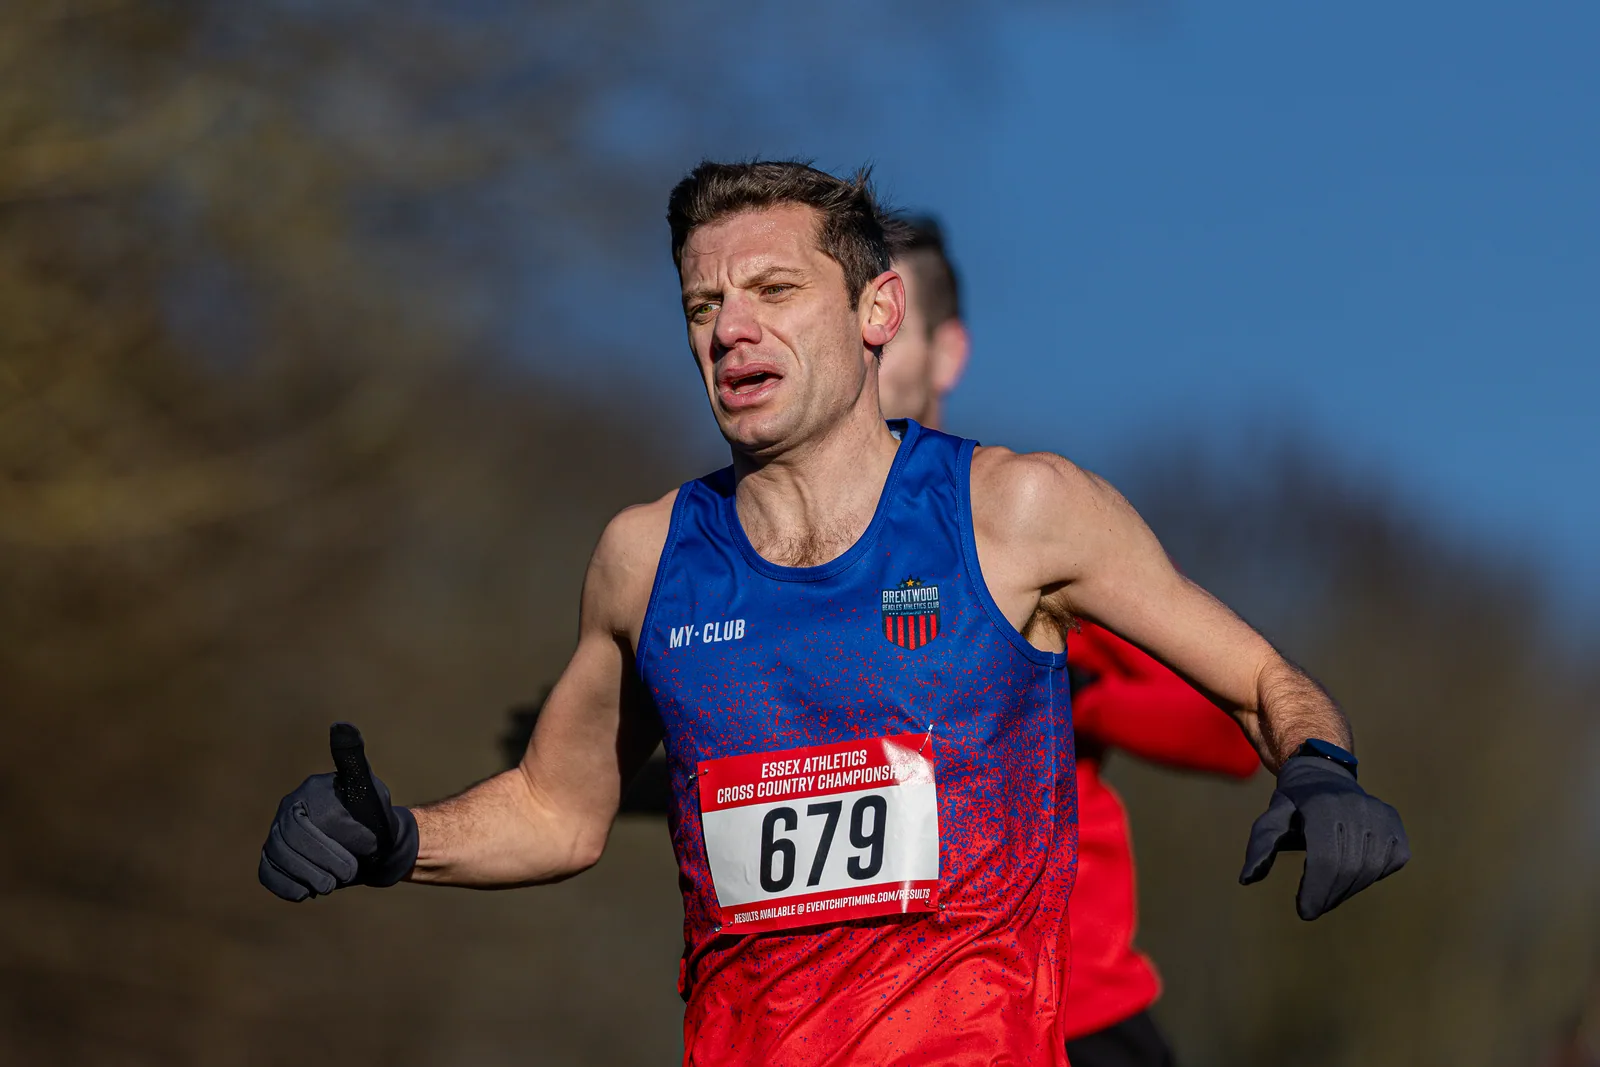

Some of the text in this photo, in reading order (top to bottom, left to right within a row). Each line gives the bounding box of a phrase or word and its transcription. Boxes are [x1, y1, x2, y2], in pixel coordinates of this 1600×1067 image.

[882, 586, 939, 603] BRENTWOOD
[903, 602, 926, 610] ATHLETICS
[927, 601, 940, 609] CLUB
[761, 749, 868, 779] ESSEX ATHLETICS
[717, 783, 754, 805] CROSS
[757, 775, 815, 798] COUNTRY
[760, 795, 887, 893] 679
[734, 888, 931, 924] RESULTS AVAILABLE @ EVENTCHIPTIMING.COM/RESULTS
